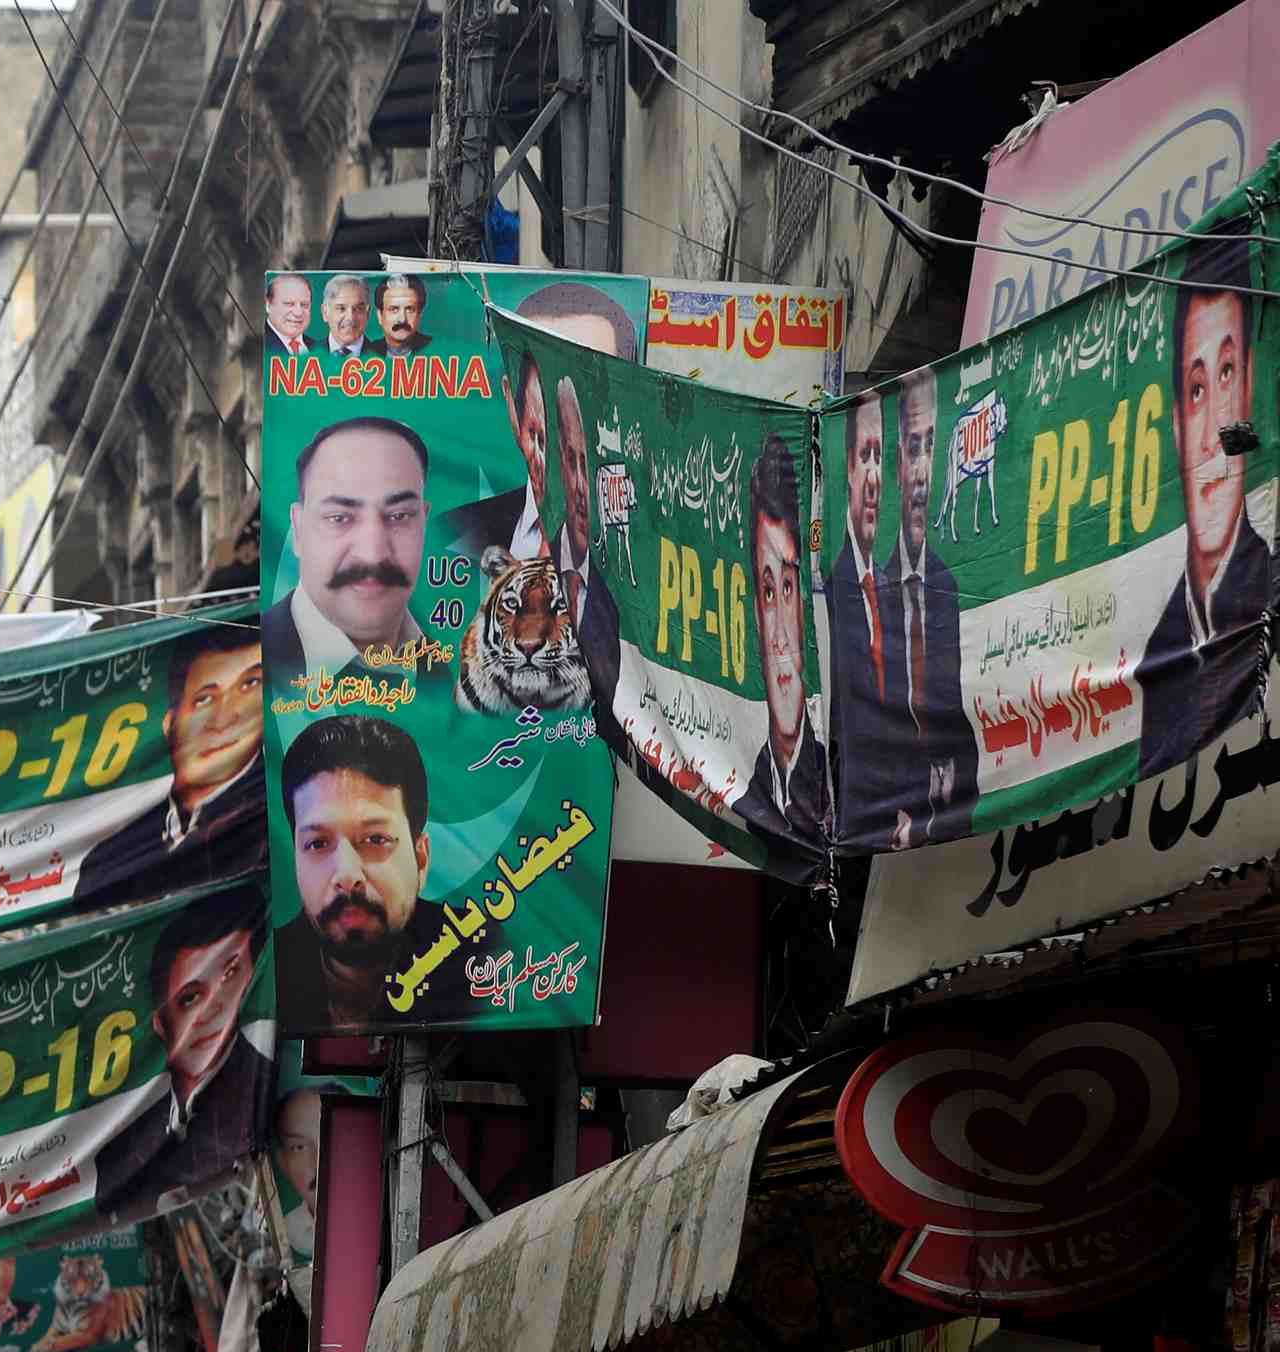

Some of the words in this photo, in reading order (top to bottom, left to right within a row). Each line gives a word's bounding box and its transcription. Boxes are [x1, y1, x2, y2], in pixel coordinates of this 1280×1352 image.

[743, 292, 845, 362] اتفاق
[269, 355, 386, 398] NA-62
[390, 356, 492, 400] MNA
[961, 407, 991, 466] VOTE
[1023, 383, 1164, 576] PP-16
[426, 556, 472, 588] UC
[430, 598, 465, 630] 40
[656, 535, 747, 686] PP-16
[467, 704, 544, 772] شیر
[484, 800, 597, 921] فیضان
[386, 897, 488, 1013] یاسین
[9, 1155, 82, 1216] شیخ
[978, 1229, 1123, 1281] WALL'S
